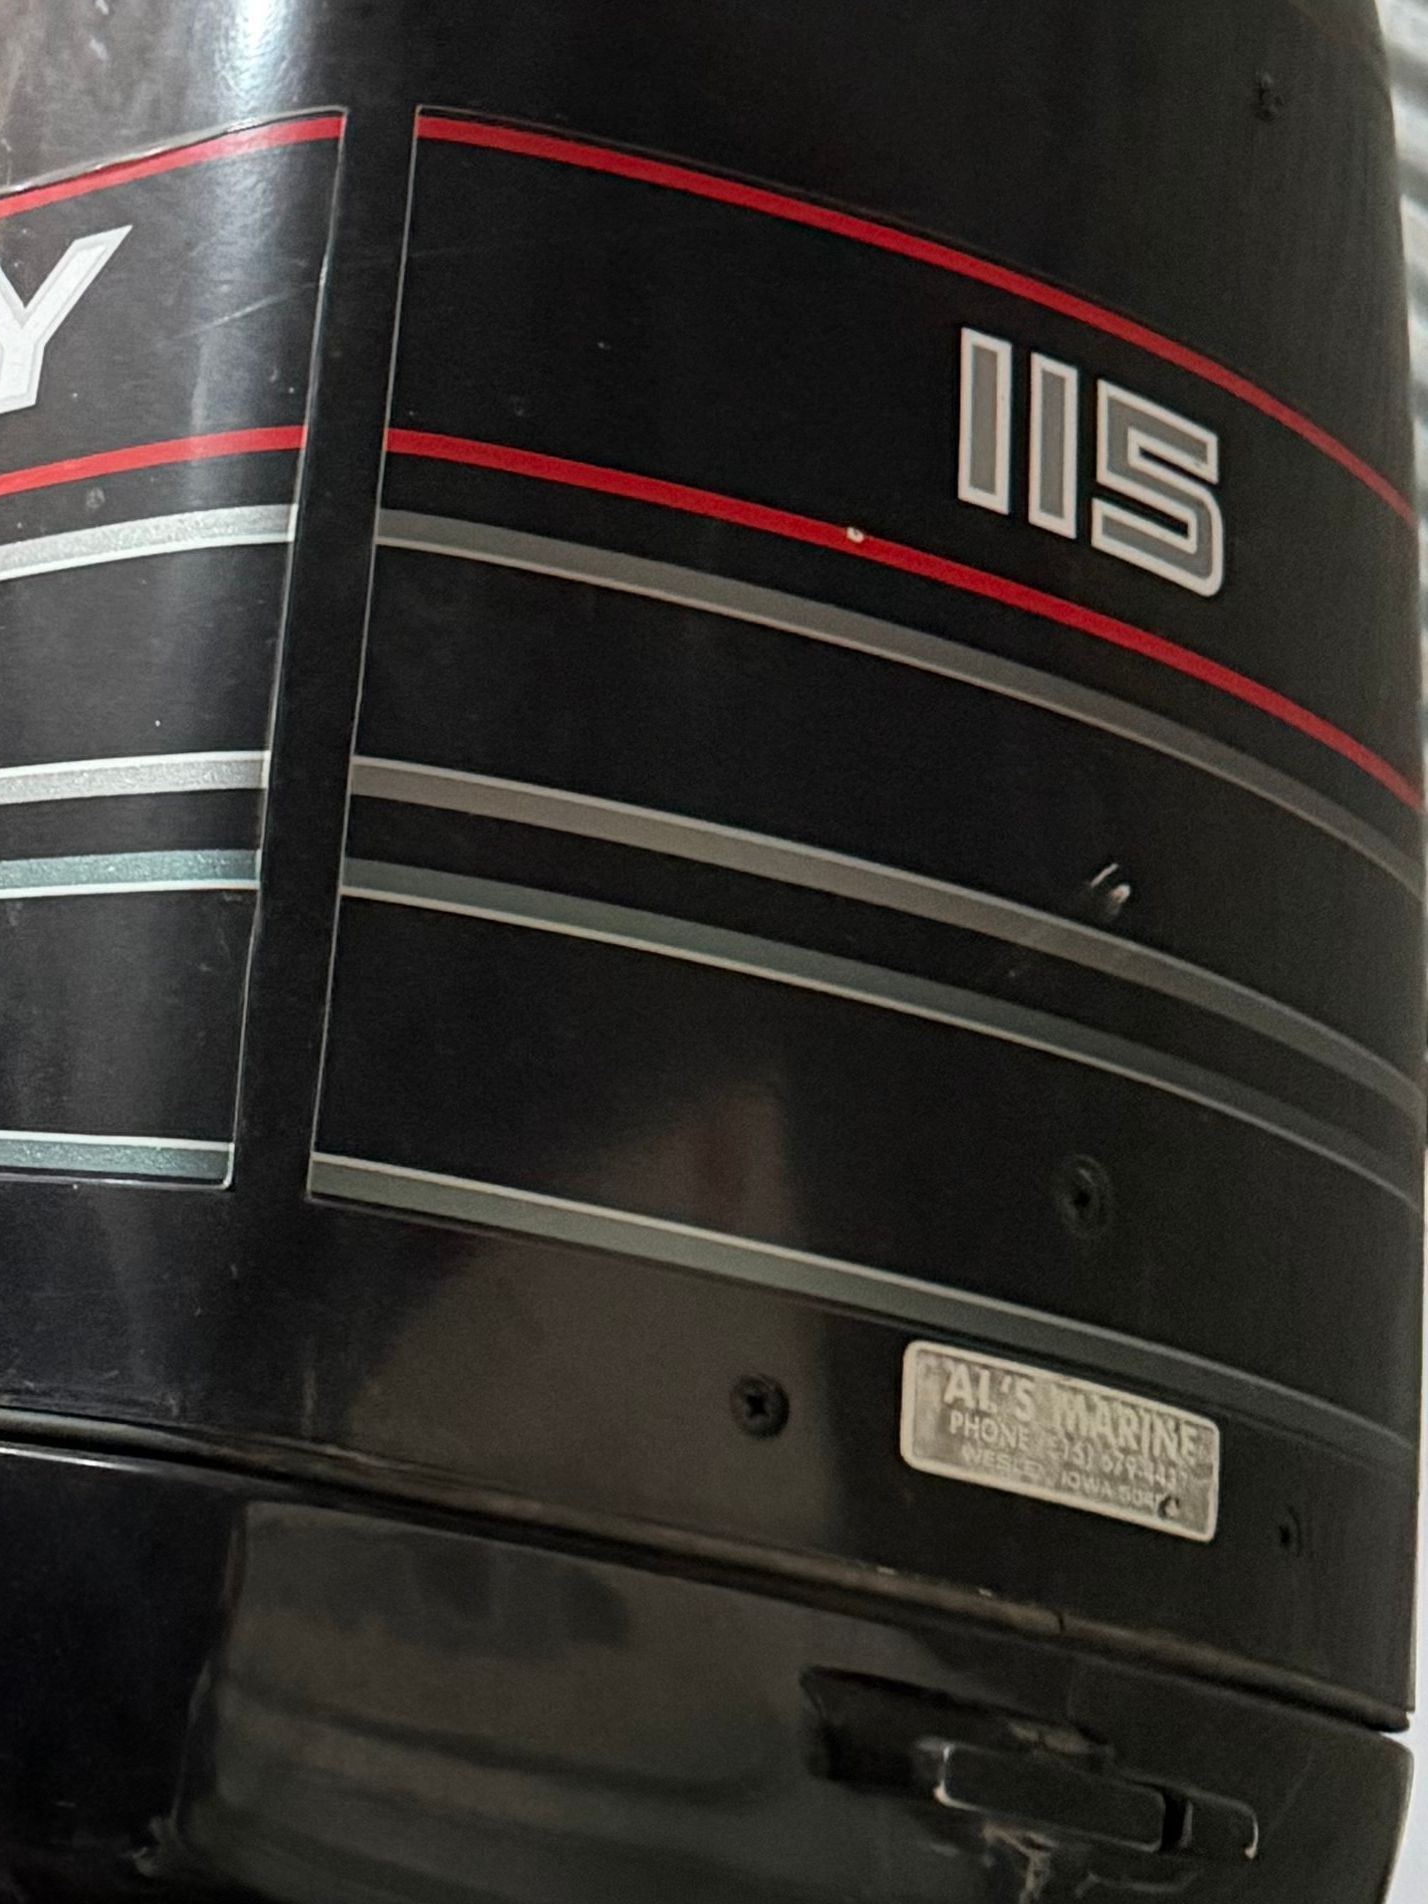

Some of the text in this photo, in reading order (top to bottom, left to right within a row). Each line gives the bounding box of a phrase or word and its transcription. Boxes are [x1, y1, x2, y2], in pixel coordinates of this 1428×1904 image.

[957, 326, 1225, 597] 115
[943, 1358, 1198, 1466] AL'S MARINE
[950, 1409, 1029, 1453] PHONE
[1061, 1469, 1114, 1499] IOWA
